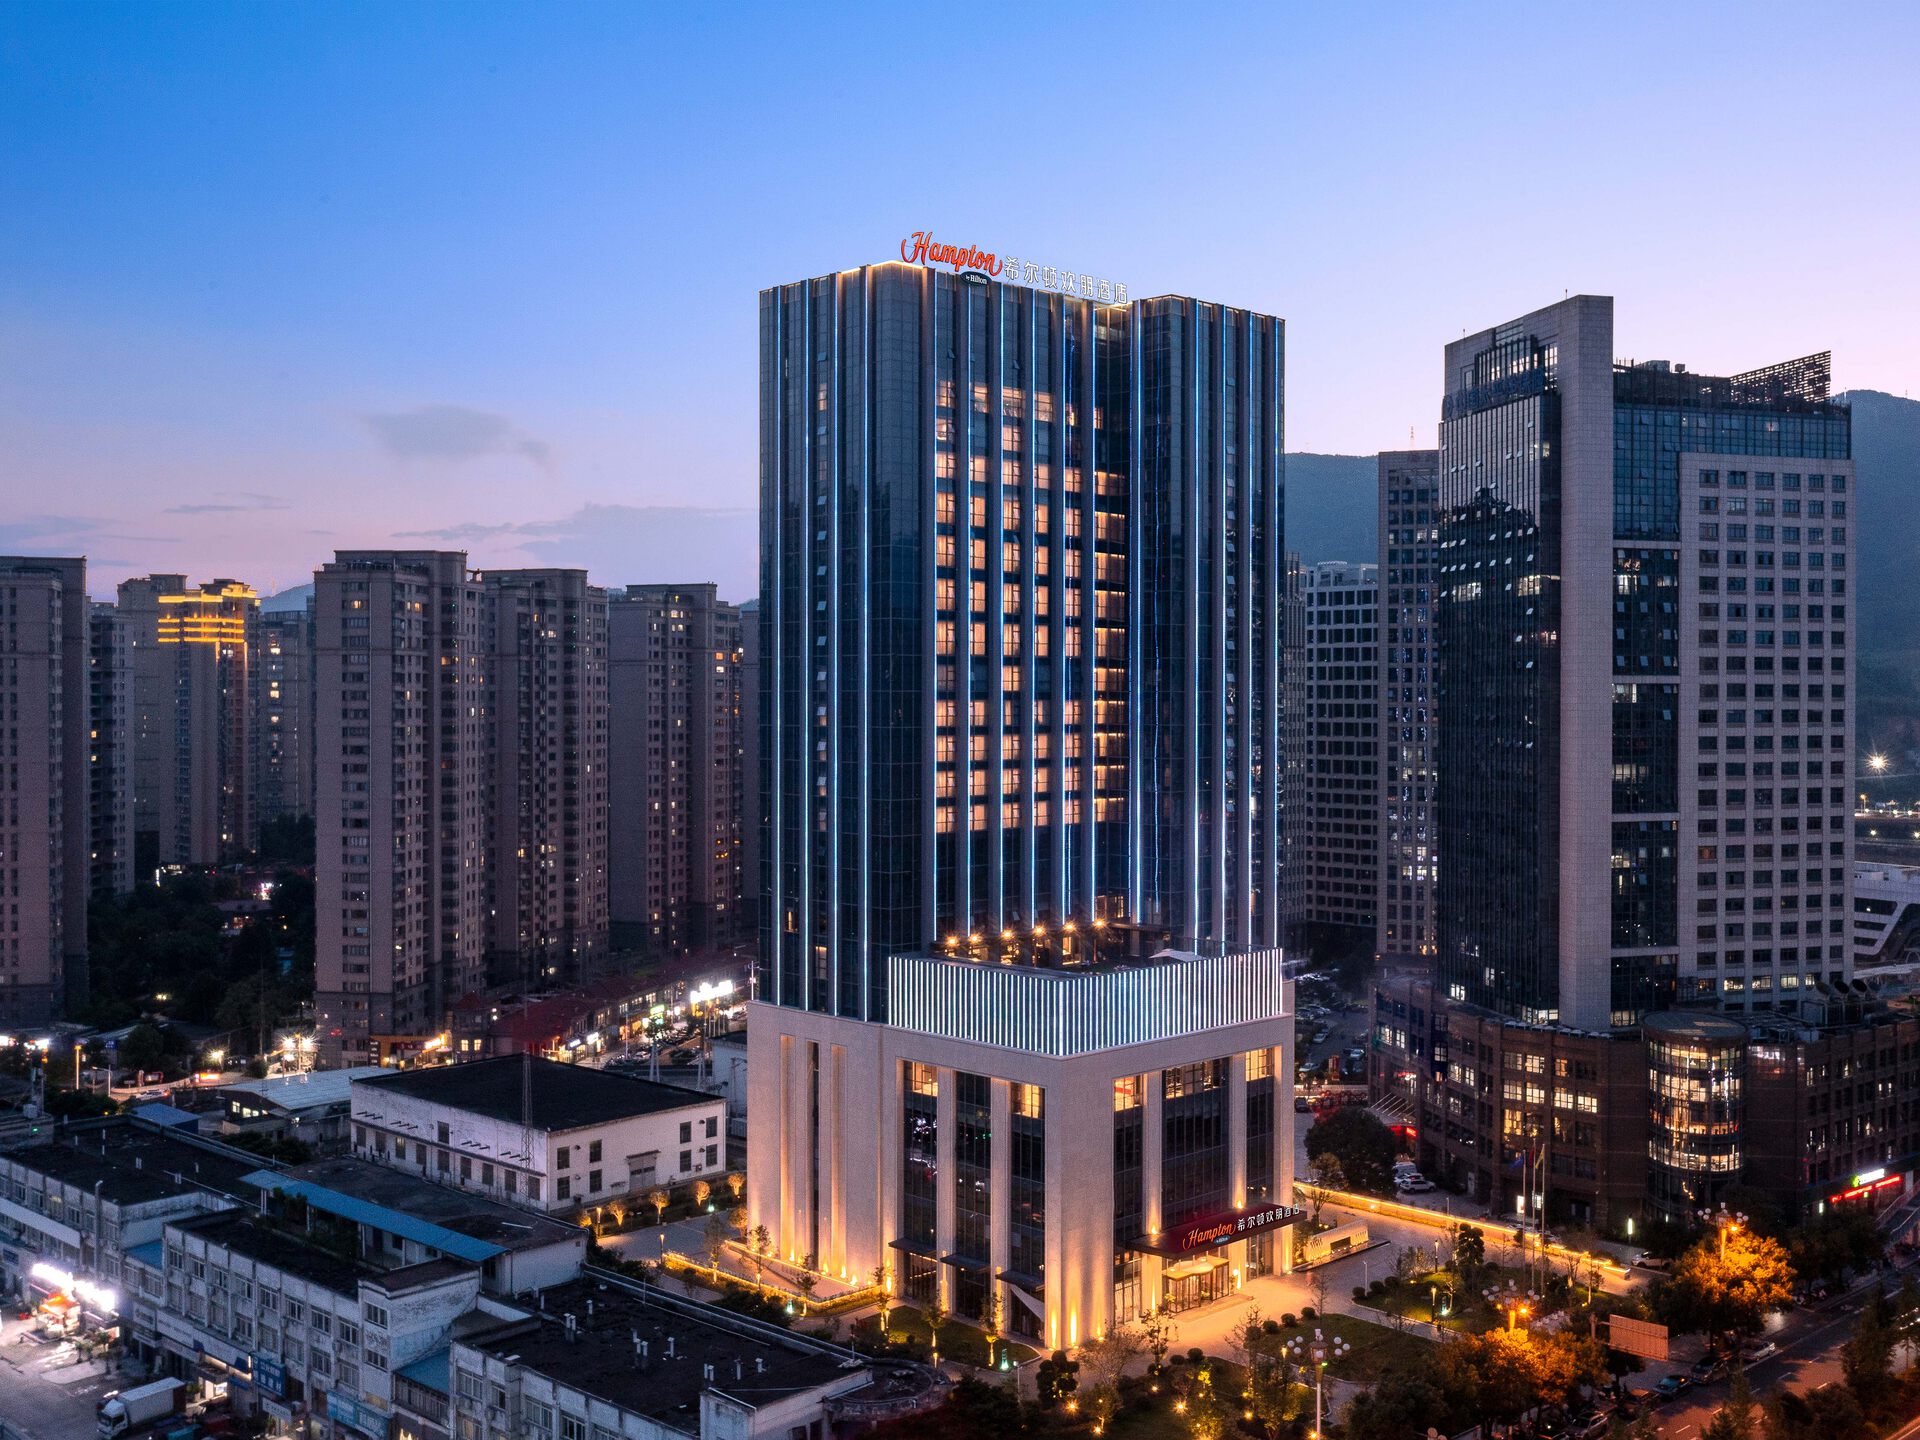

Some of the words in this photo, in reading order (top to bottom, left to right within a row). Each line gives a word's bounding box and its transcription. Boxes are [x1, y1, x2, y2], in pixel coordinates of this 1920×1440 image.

[901, 231, 1003, 277] Hampton
[970, 274, 988, 285] Hilton
[1004, 255, 1128, 304] 希尔顿欢朋酒店
[1237, 1203, 1300, 1232] 希尔顿欢朋酒店
[1182, 1222, 1236, 1250] Hampton
